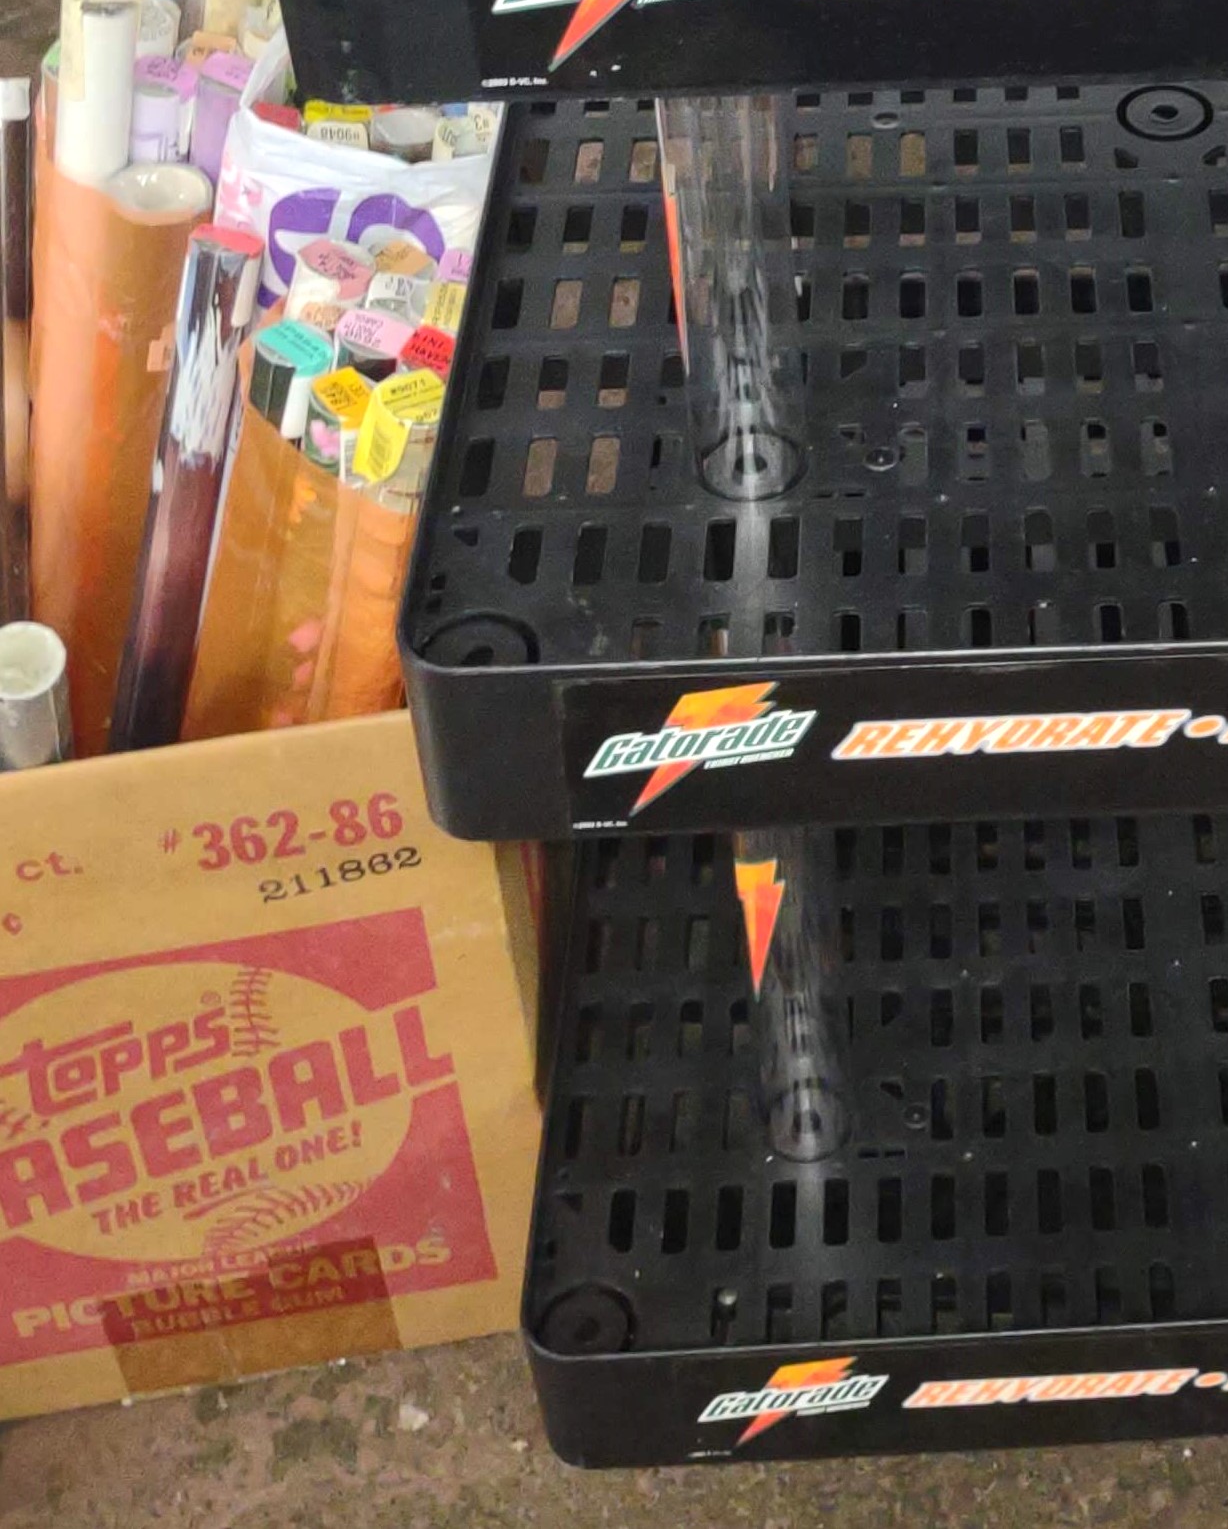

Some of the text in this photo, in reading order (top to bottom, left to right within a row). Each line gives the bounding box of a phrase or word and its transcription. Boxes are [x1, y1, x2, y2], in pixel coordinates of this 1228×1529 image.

[586, 711, 816, 777] Gatorade
[832, 711, 1190, 759] REHYDRATE
[258, 846, 423, 904] 211862
[91, 1120, 363, 1236] THE REAL ONE!
[12, 1235, 453, 1339] PICTURE CARDS
[699, 1374, 888, 1422] Gatorade
[903, 1368, 1200, 1409] REHYDRATE
